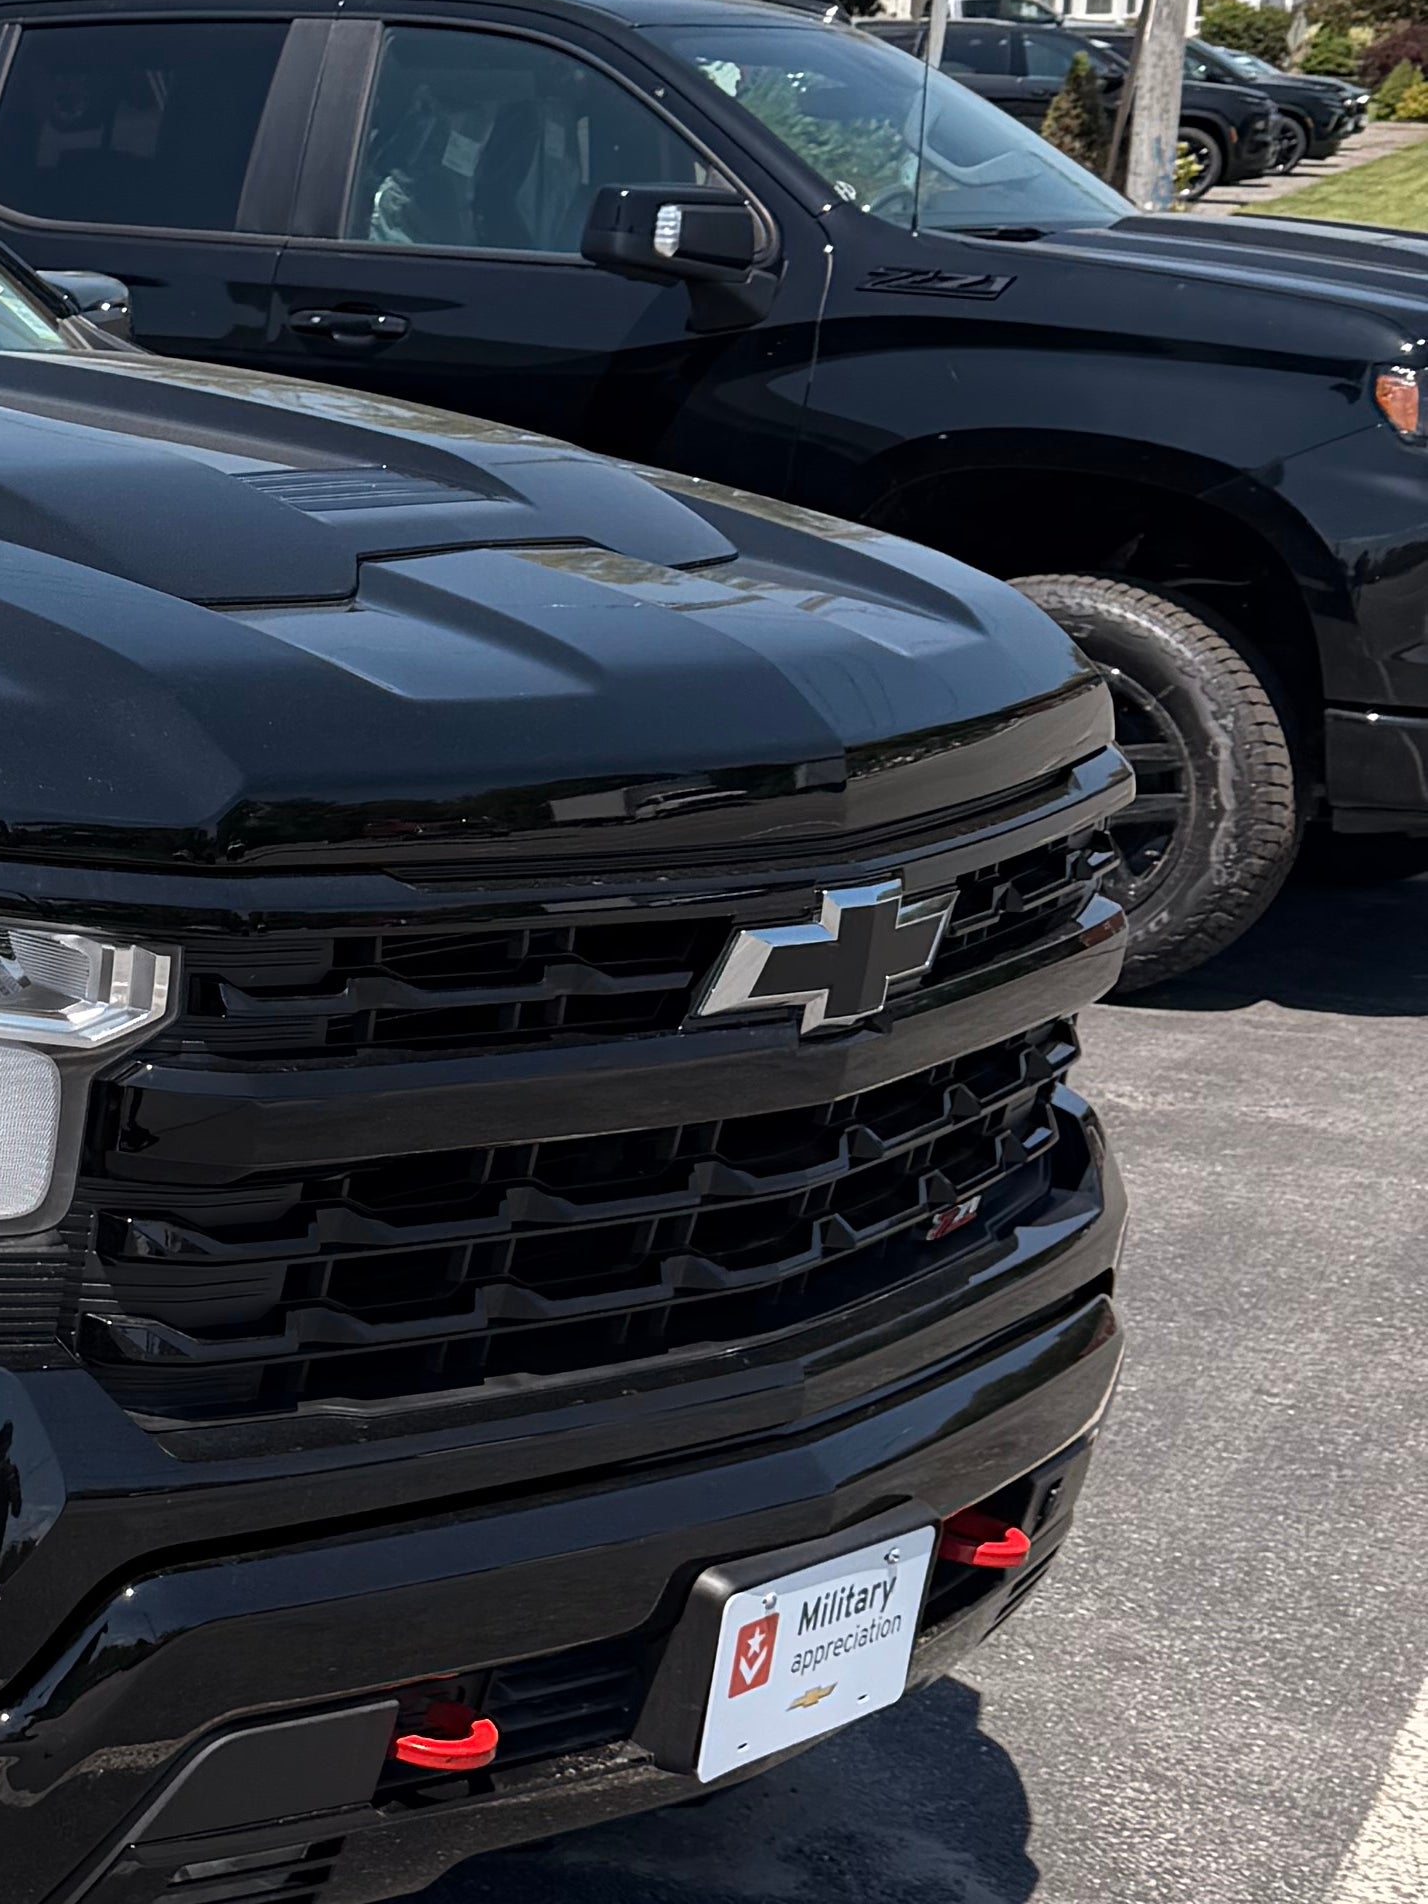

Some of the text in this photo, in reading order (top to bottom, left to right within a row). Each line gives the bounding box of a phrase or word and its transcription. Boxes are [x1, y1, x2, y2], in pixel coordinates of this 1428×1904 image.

[855, 266, 1018, 301] Z71
[926, 1195, 982, 1240] Z71
[796, 1576, 898, 1636] Military
[790, 1614, 902, 1676] appreciation
